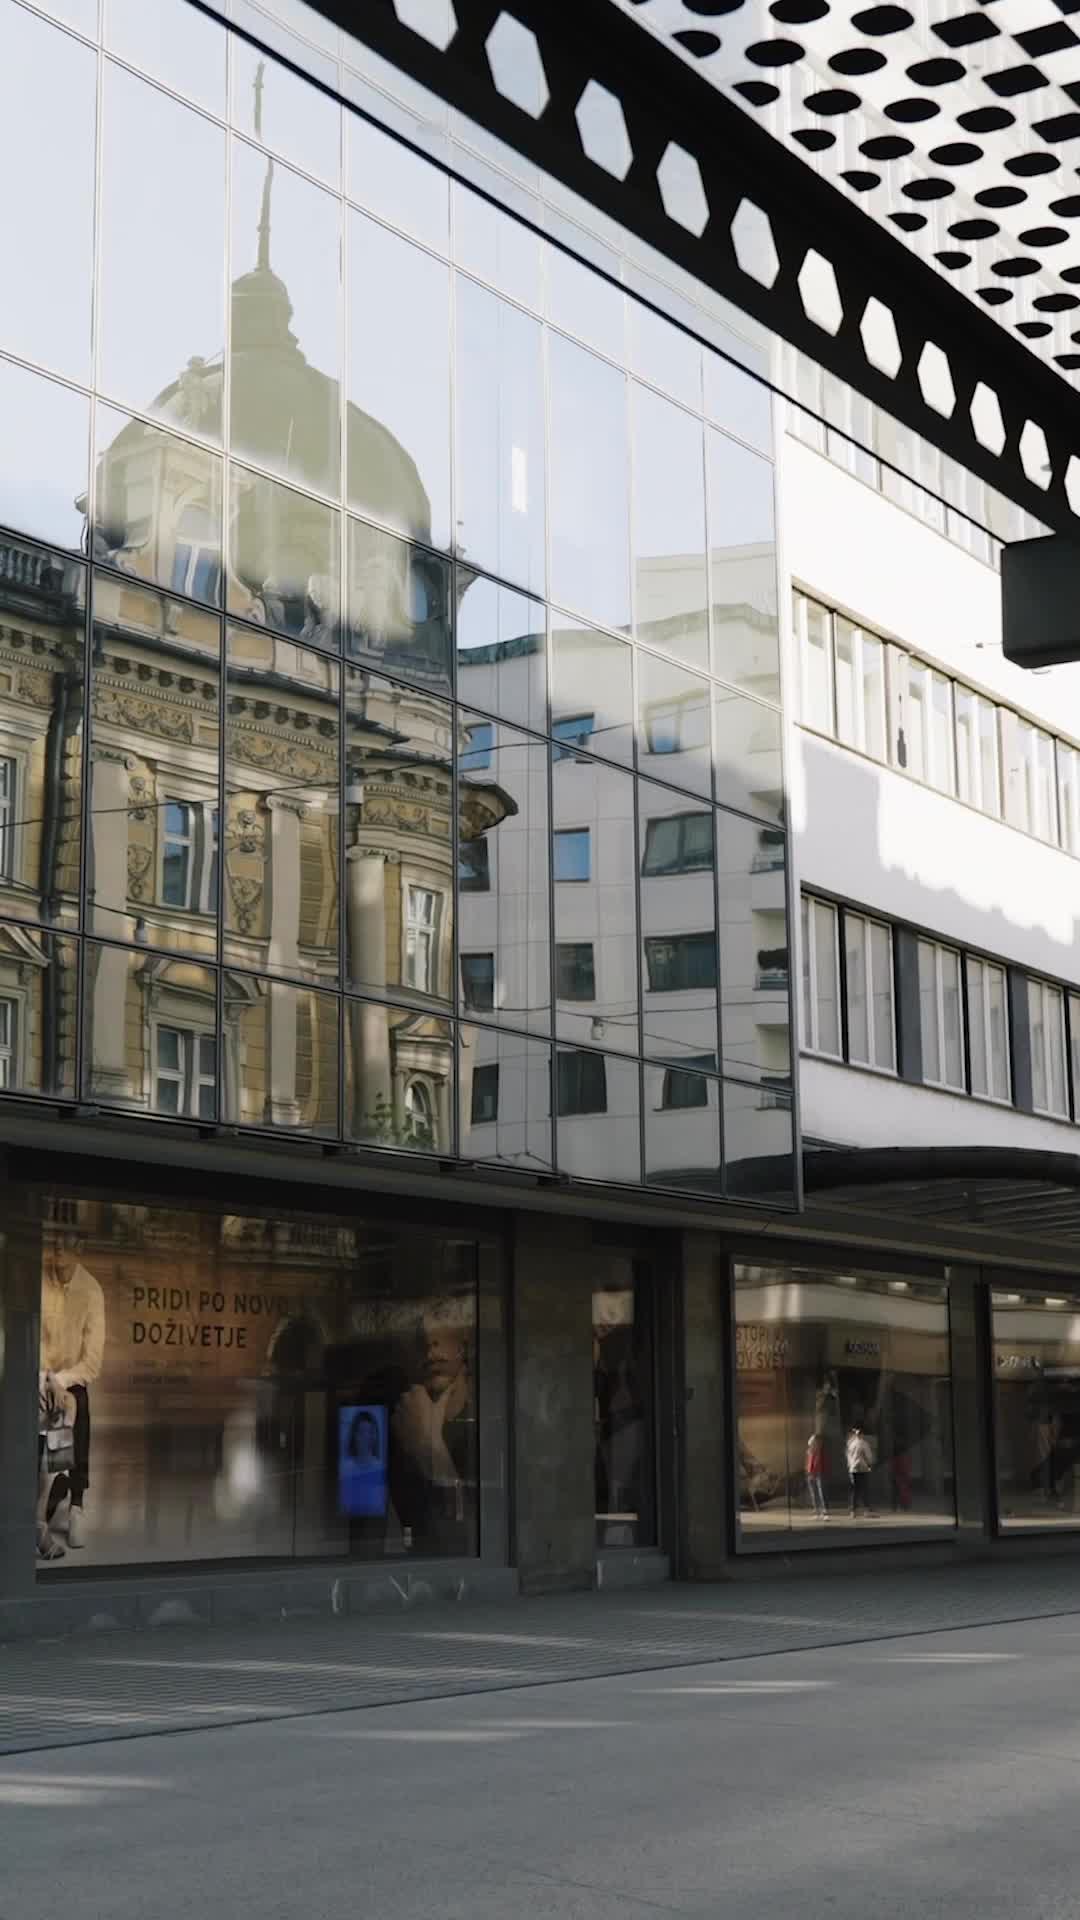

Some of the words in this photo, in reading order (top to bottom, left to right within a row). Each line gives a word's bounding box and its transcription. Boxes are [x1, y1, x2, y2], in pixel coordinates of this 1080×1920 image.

[133, 1287, 191, 1310] PRIDI
[200, 1291, 225, 1313] PO
[133, 1318, 247, 1348] DOŽIVETJE
